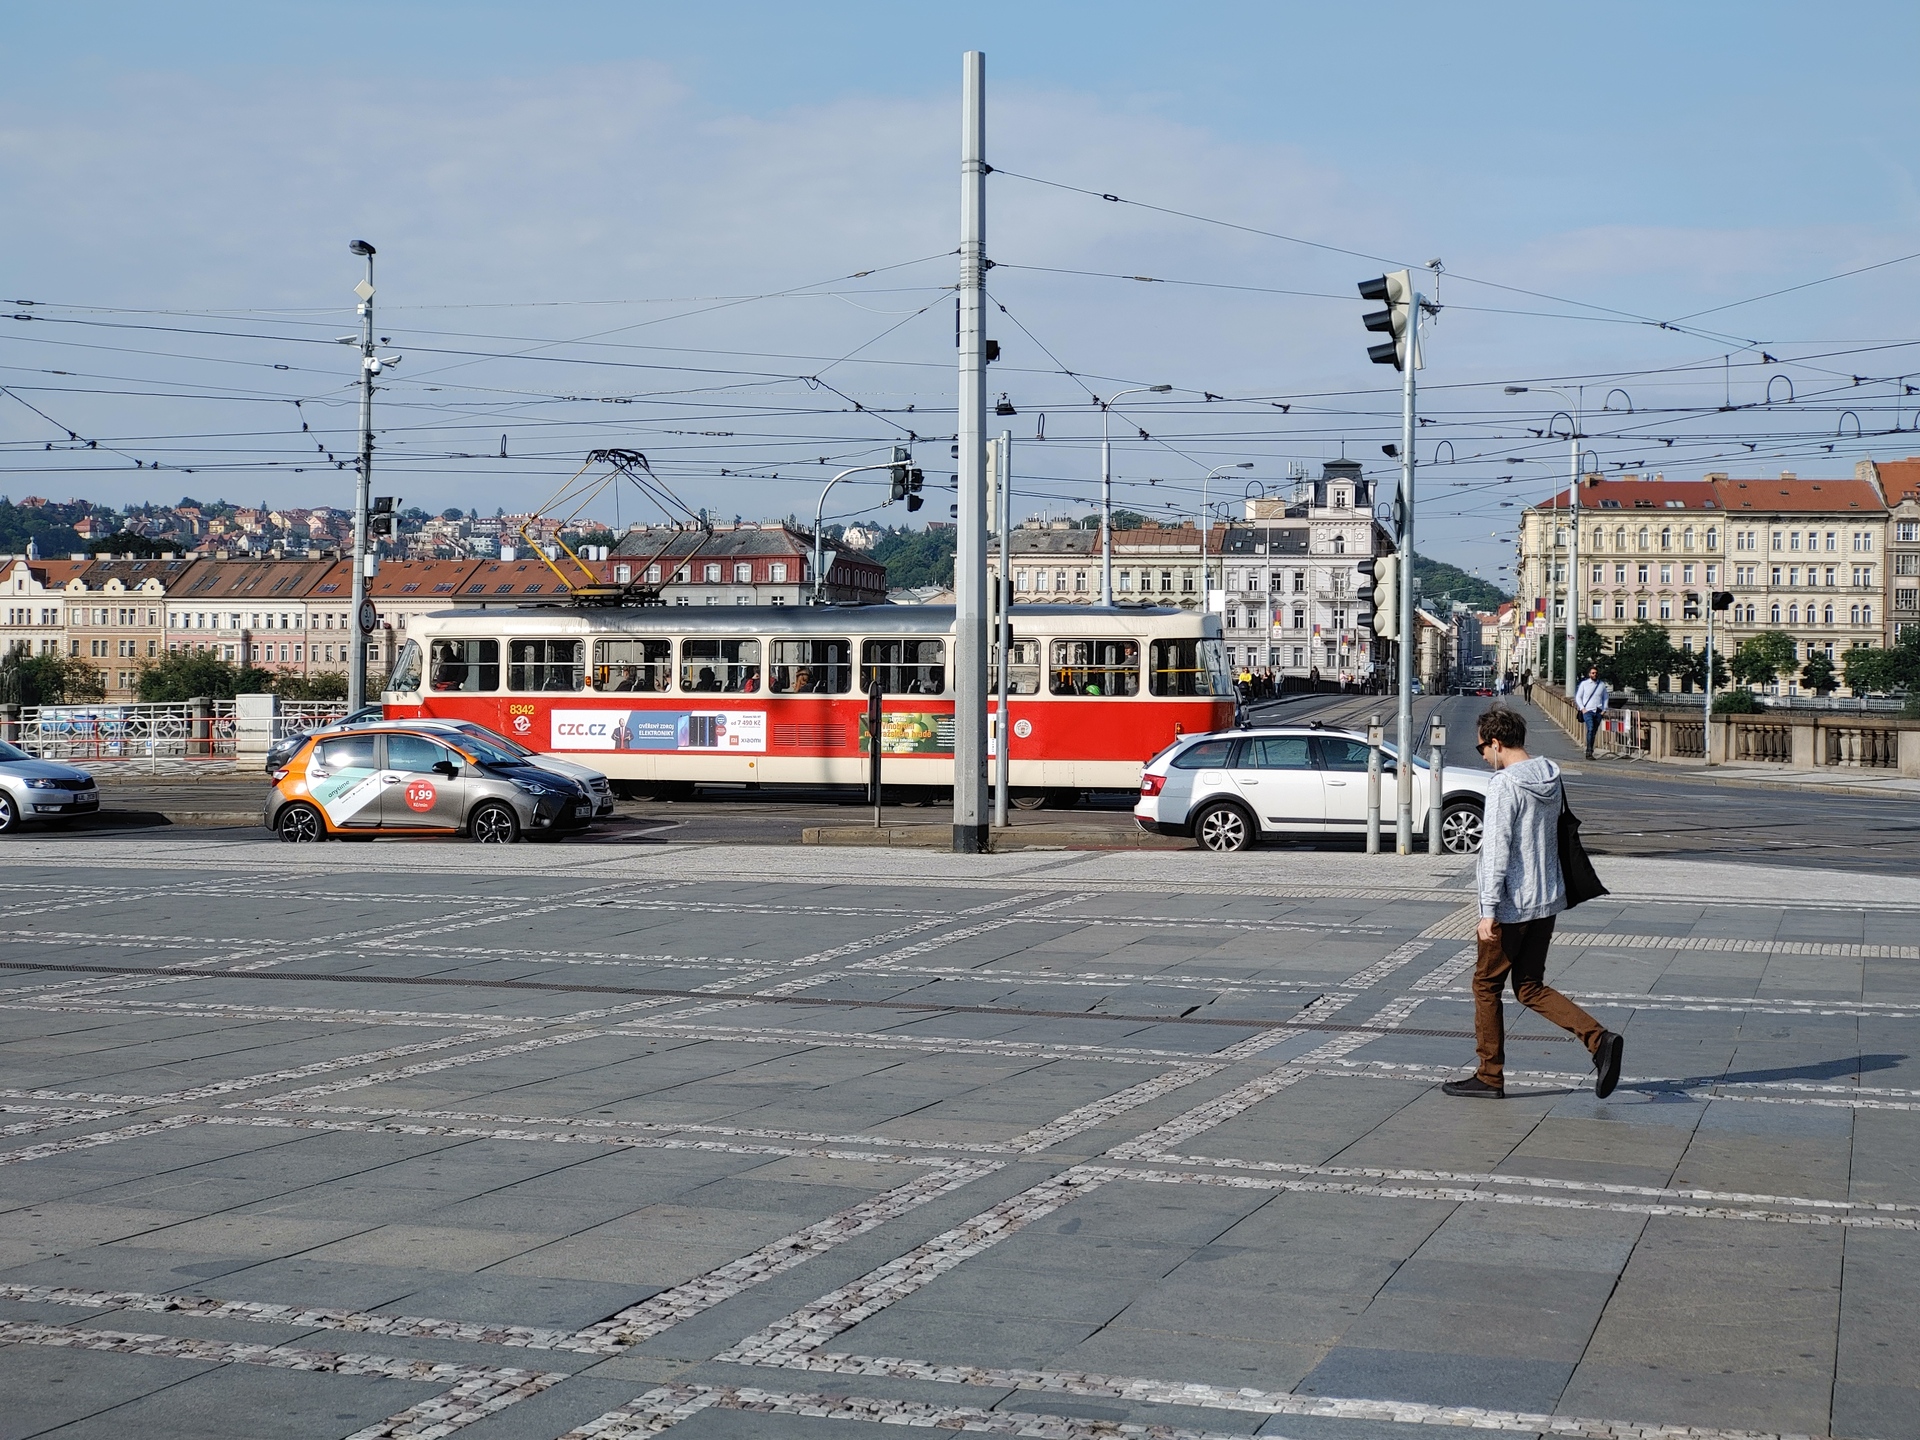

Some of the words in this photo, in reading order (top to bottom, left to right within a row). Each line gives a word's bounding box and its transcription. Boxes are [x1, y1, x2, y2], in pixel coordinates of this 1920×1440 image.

[510, 705, 534, 714] 8342
[558, 724, 606, 736] CZC.CZ
[328, 780, 350, 798] anytime
[409, 790, 432, 800] 1,99
